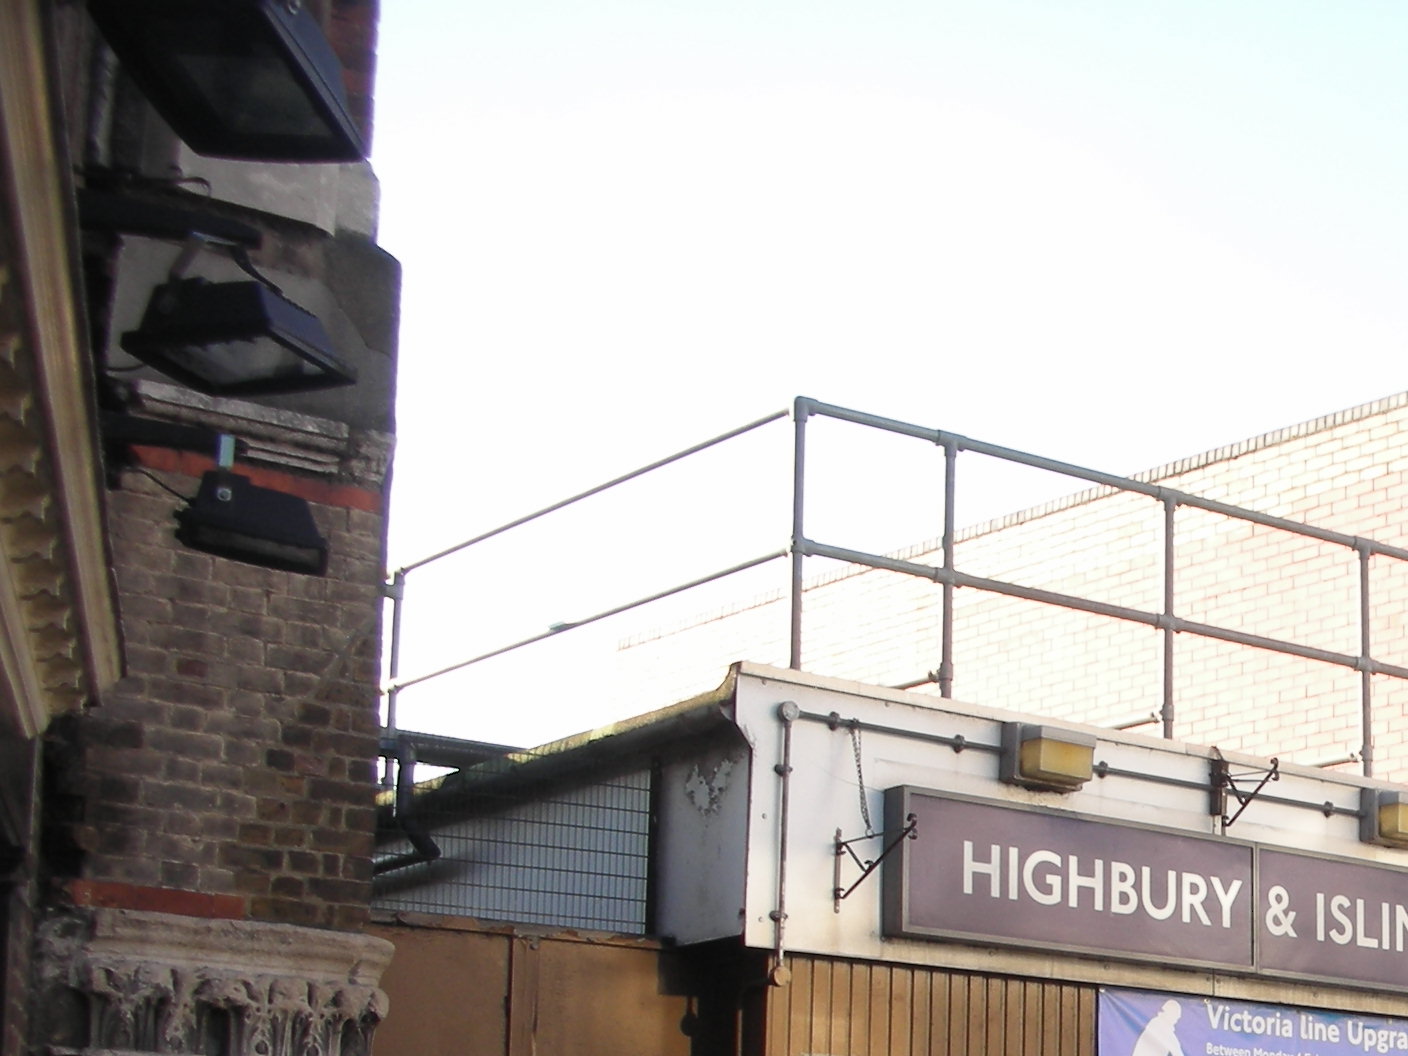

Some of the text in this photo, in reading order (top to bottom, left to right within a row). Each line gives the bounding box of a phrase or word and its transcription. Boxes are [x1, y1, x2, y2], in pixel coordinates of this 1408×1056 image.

[963, 840, 1243, 929] HIGHBURY
[1265, 885, 1297, 938] &
[1206, 1004, 1293, 1038] Victoria
[1300, 1015, 1340, 1043] line
